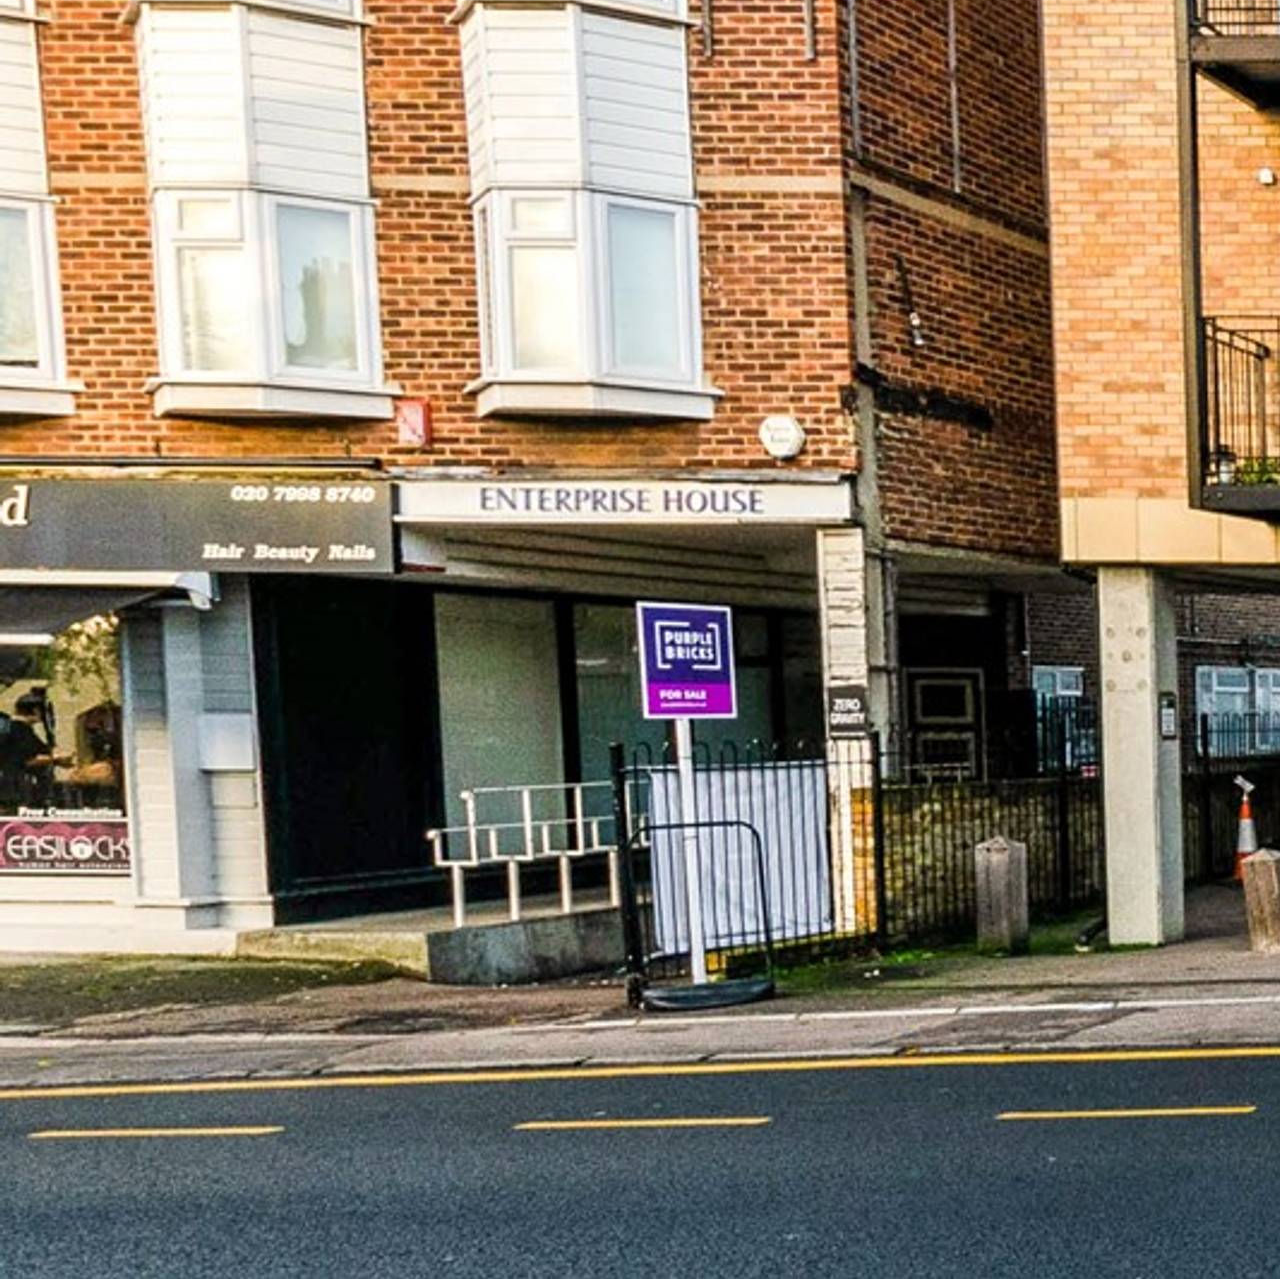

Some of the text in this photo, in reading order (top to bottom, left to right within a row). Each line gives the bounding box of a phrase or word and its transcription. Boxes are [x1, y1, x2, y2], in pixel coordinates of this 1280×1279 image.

[231, 486, 269, 502] 020
[325, 487, 375, 503] 8740
[479, 487, 765, 513] ENTERPRISE HOUSE
[201, 543, 376, 563] Hair Beauty Nails
[663, 631, 713, 646] PURPLE
[664, 645, 714, 661] BRICKS
[659, 689, 707, 700] FOR SALE
[833, 698, 861, 711] ZERO
[7, 835, 130, 860] EASILOCK
